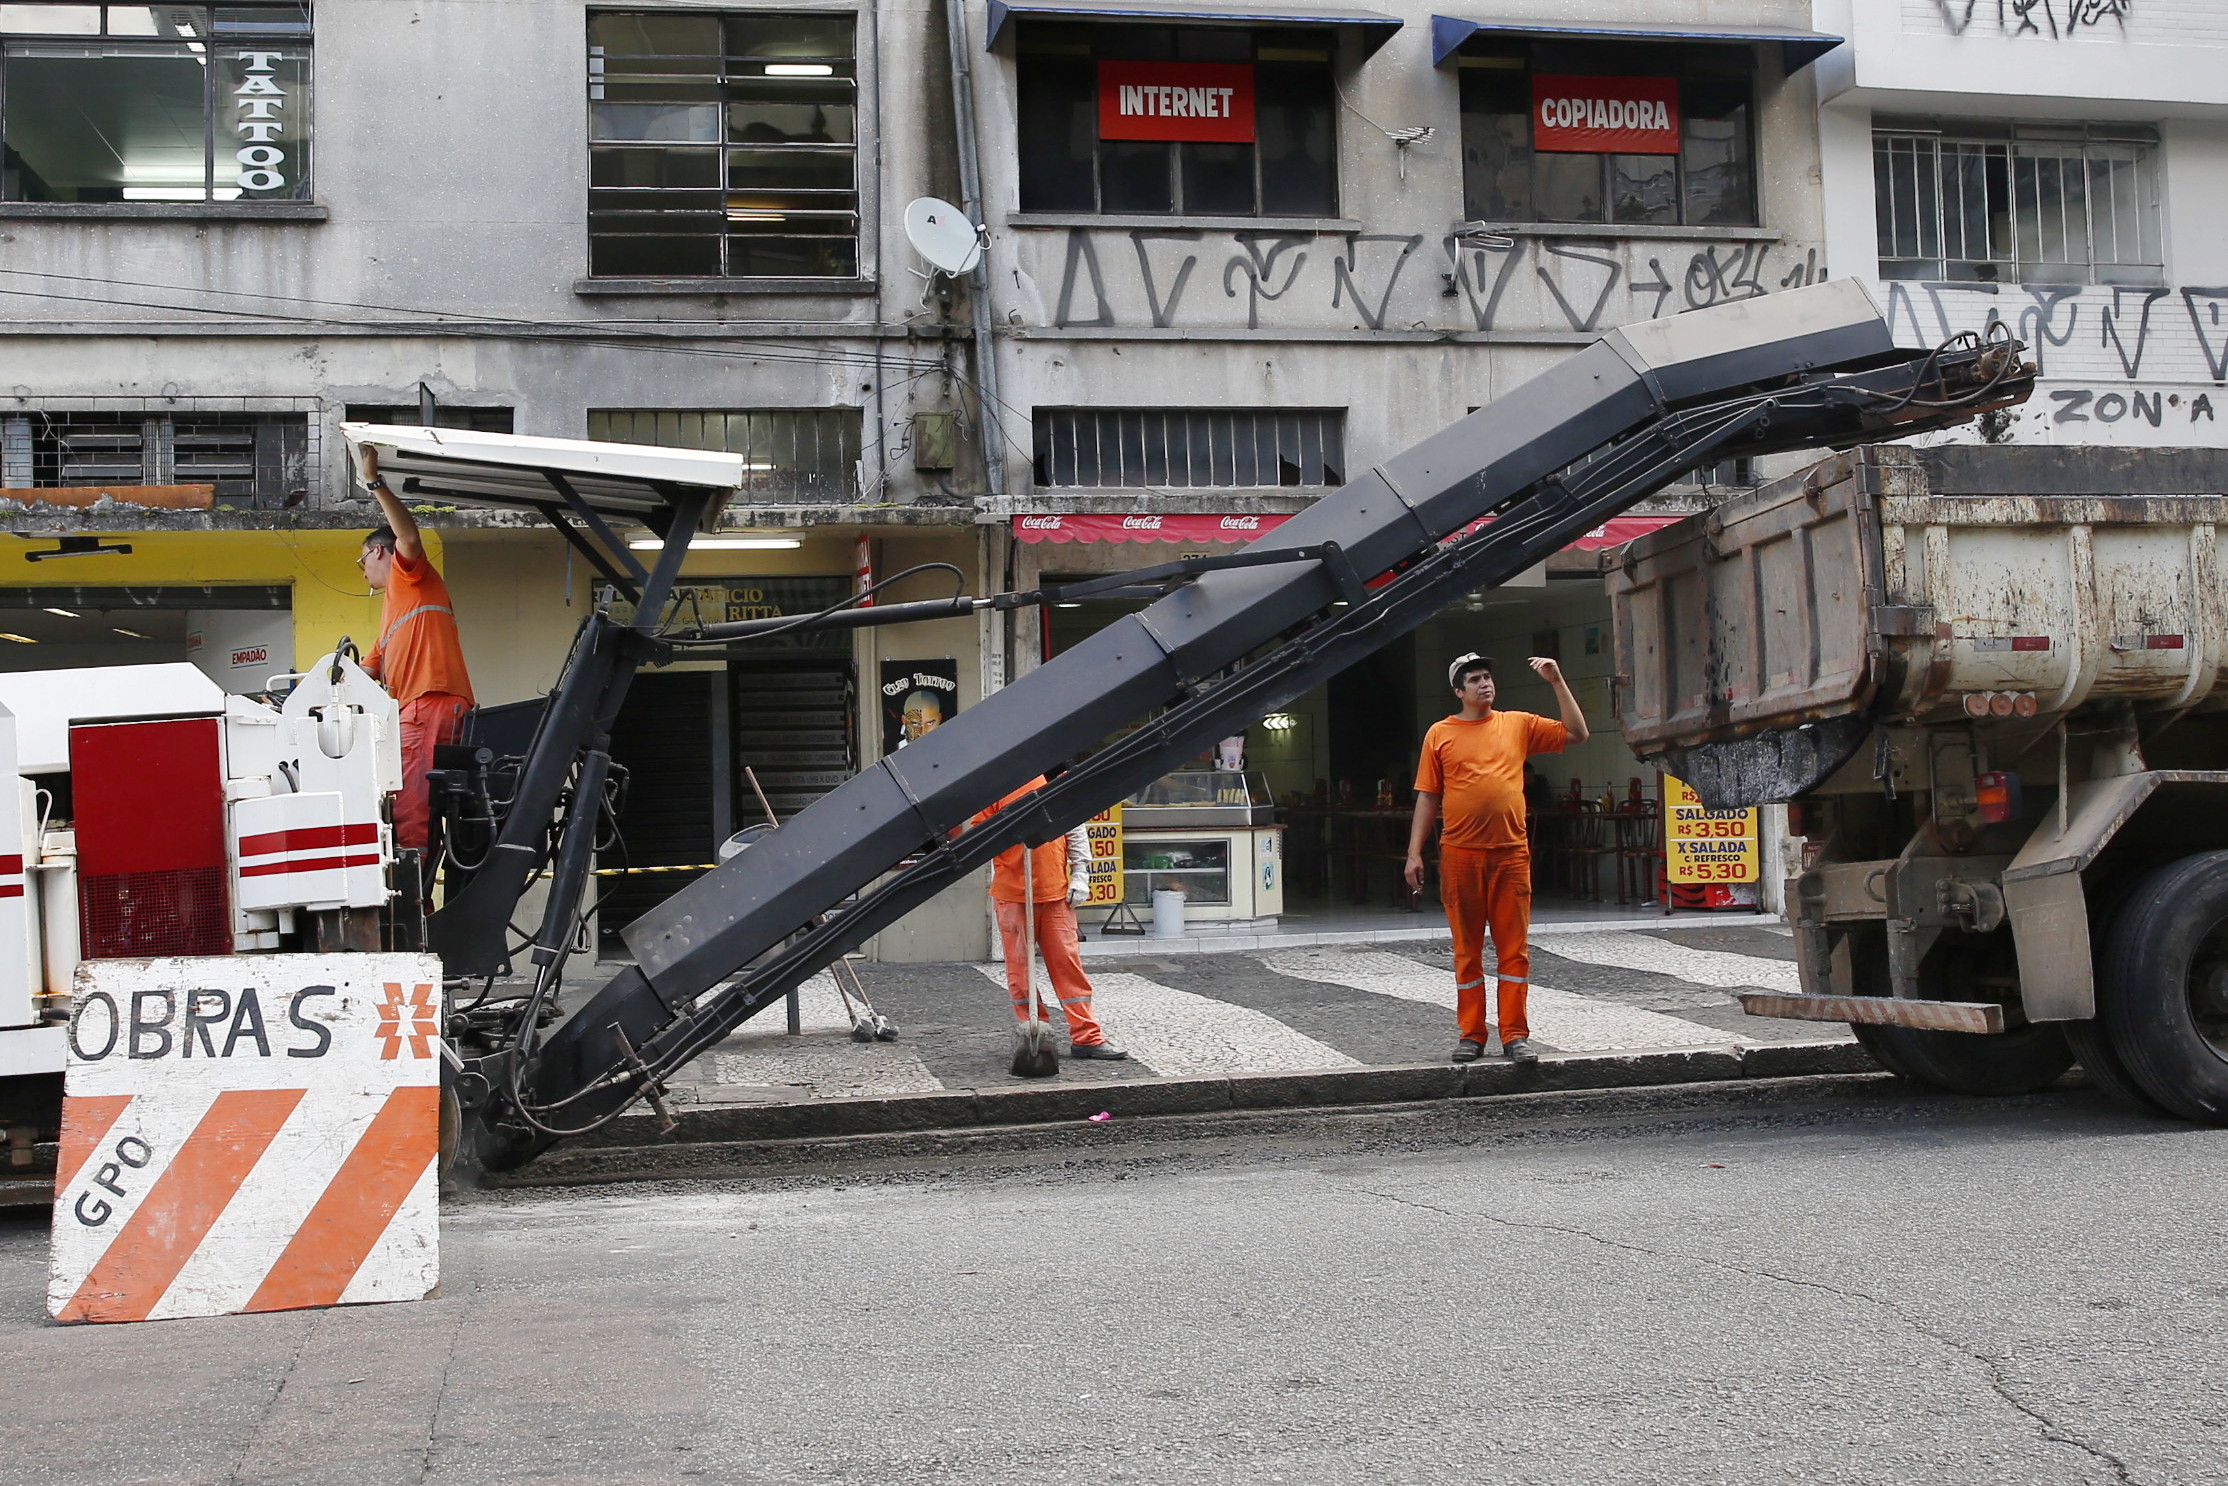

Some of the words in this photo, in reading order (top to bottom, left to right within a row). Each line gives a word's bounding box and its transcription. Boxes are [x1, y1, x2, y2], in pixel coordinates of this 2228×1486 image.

[1119, 84, 1233, 118] INTERNET
[233, 51, 288, 190] TATTOO
[1541, 98, 1670, 130] COPIADORA
[232, 648, 267, 665] EMPADÃO
[1675, 809, 1749, 820] SALGADO
[1087, 826, 1117, 838] GADO
[1678, 824, 1692, 835] R$
[1695, 821, 1746, 838] 3,50
[1678, 842, 1686, 853] X
[1690, 841, 1747, 853] SALADA
[1694, 854, 1740, 862] REFRESCO
[1089, 875, 1112, 883] FRESCO
[1679, 865, 1693, 876] R$
[1697, 863, 1747, 880] 5,30
[69, 985, 336, 1061] OBRAS
[74, 1136, 154, 1227] GPO
